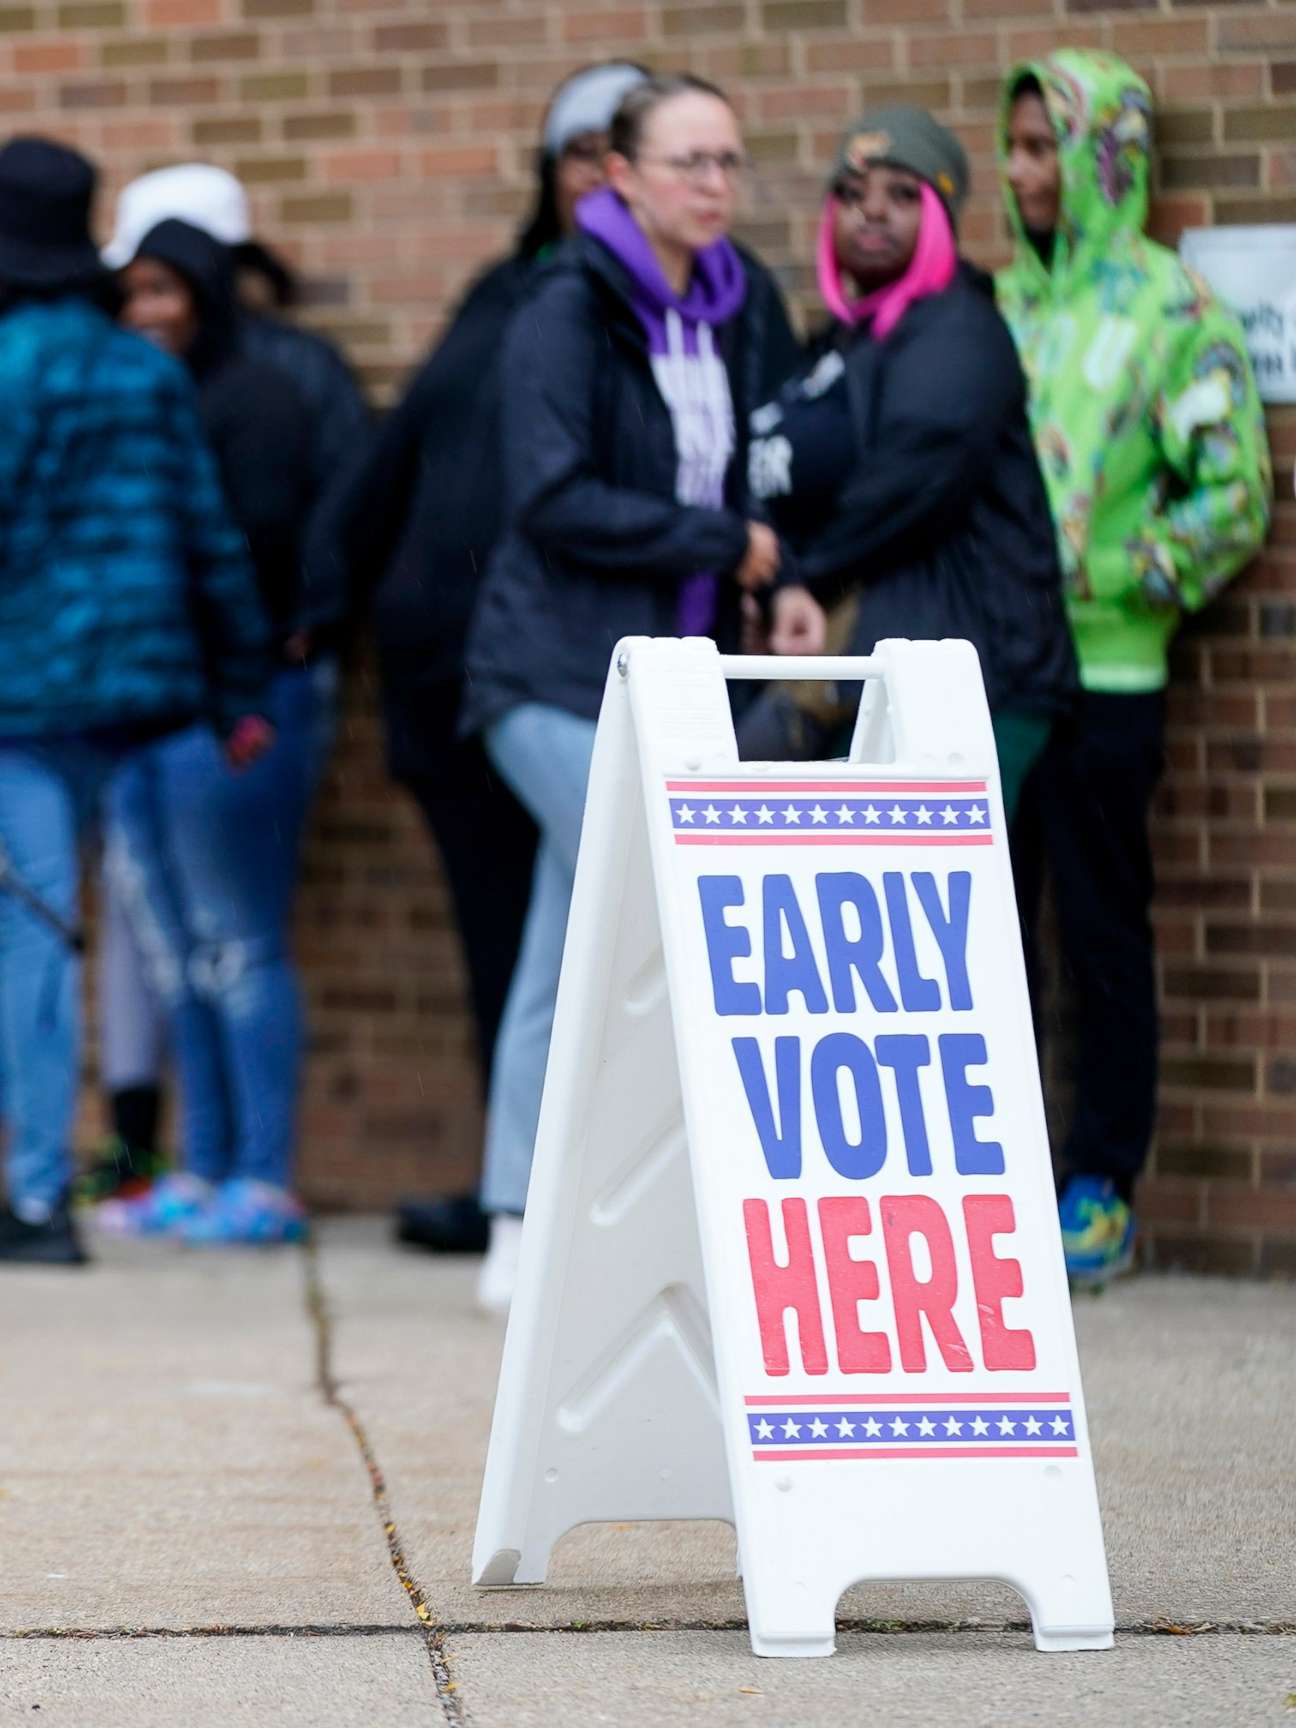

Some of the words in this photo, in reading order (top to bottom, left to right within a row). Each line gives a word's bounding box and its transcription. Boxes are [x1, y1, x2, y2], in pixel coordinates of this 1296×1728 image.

[697, 871, 975, 1016] EARLY
[731, 1032, 1007, 1180] VOTE
[743, 1194, 1037, 1376] HERE
